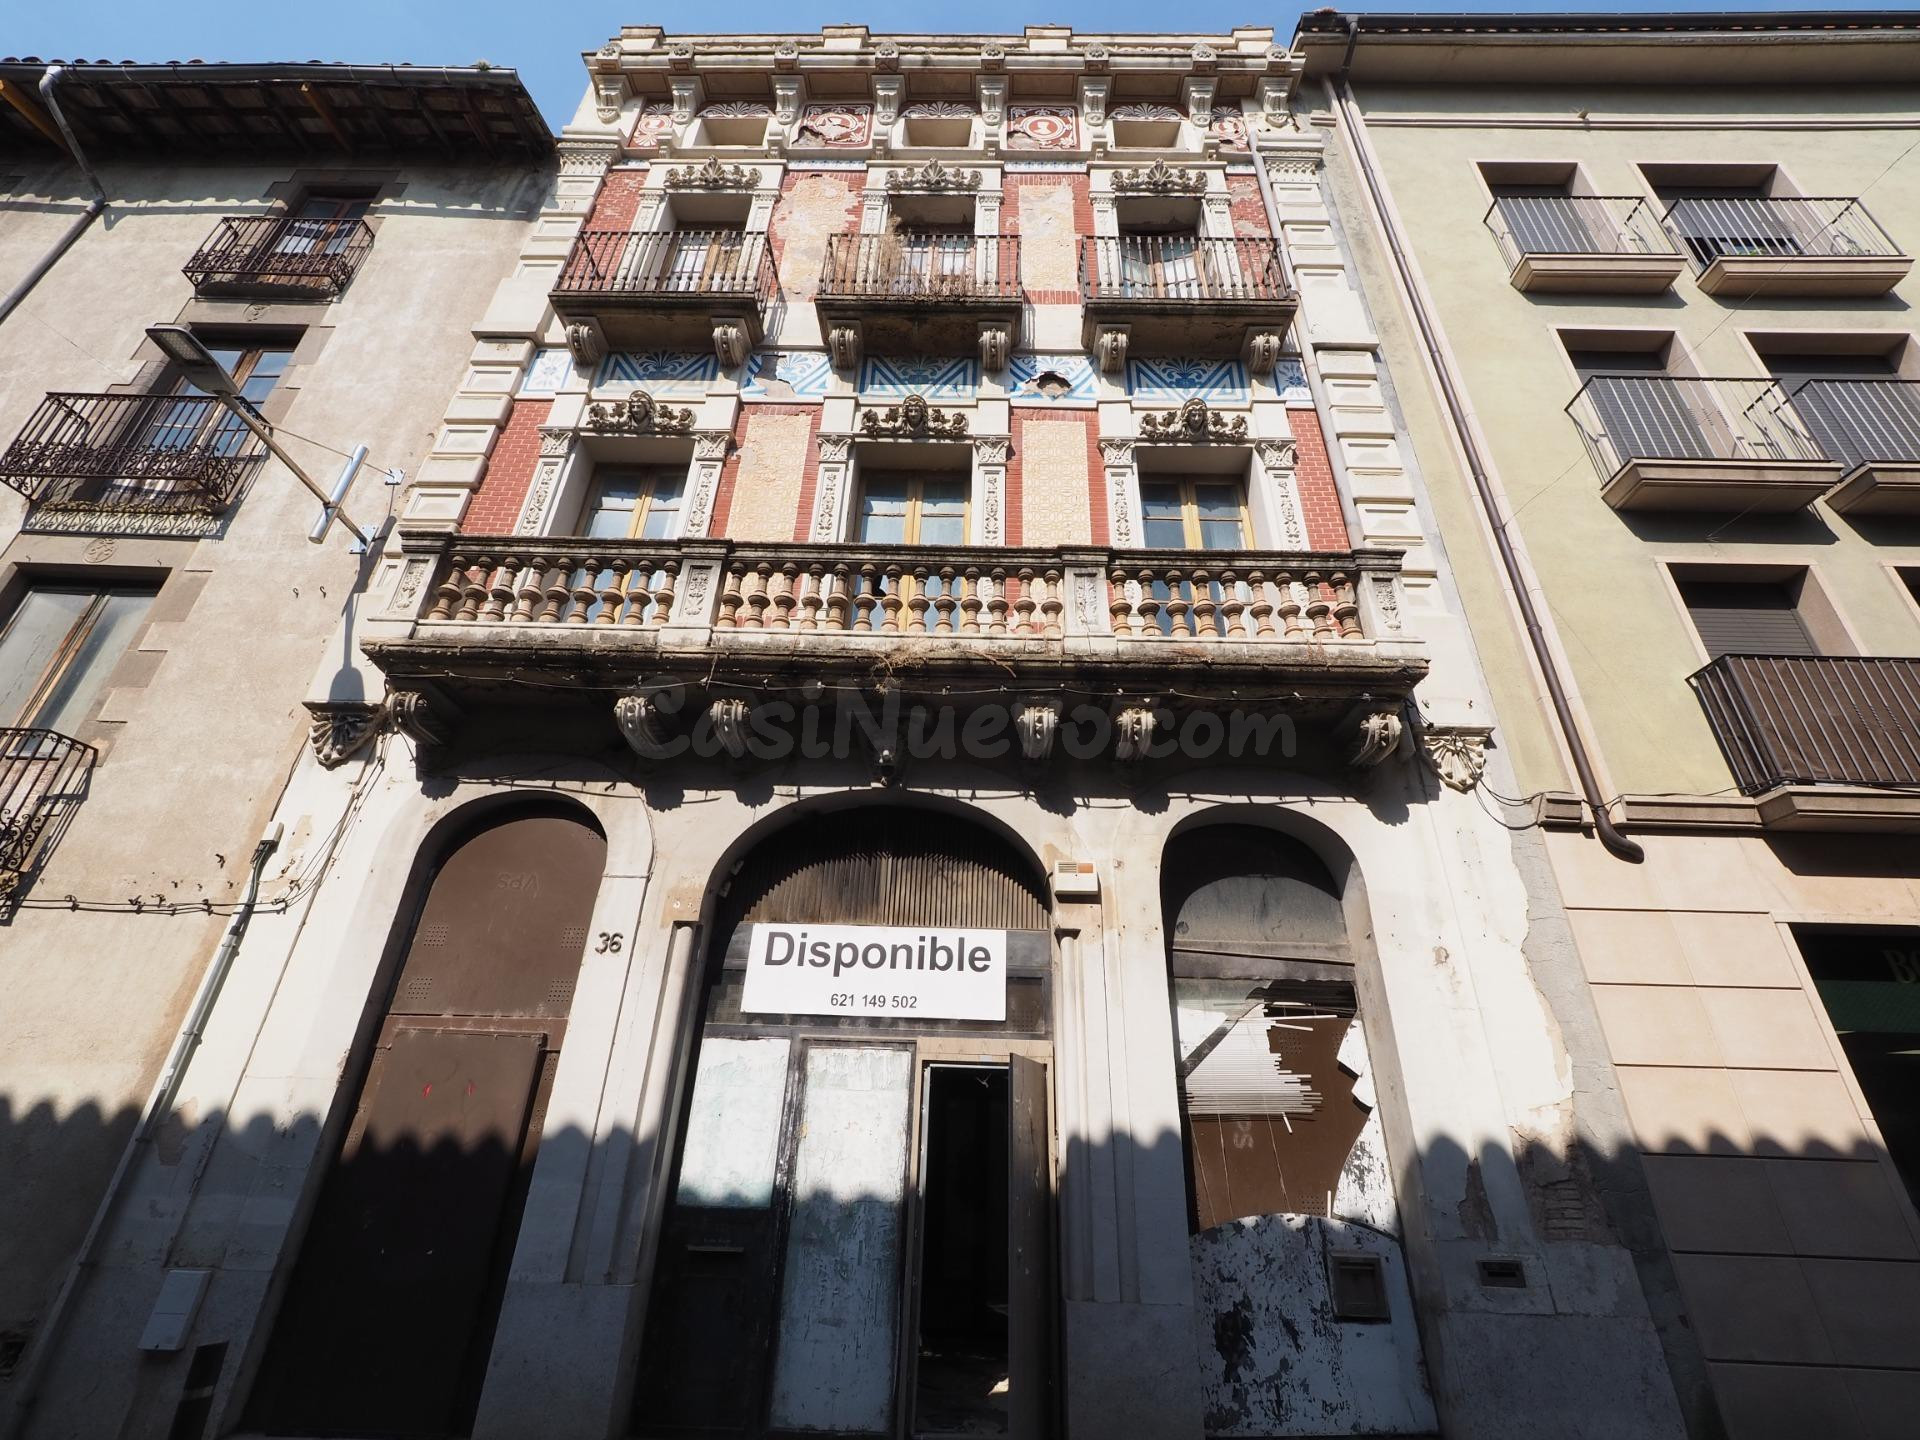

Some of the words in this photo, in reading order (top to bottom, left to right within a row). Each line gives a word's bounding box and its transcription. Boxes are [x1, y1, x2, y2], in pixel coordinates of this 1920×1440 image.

[595, 932, 624, 954] 36
[764, 931, 992, 977] Disponible
[830, 993, 855, 1007] 621
[861, 994, 886, 1008] 149
[891, 996, 917, 1009] 502
